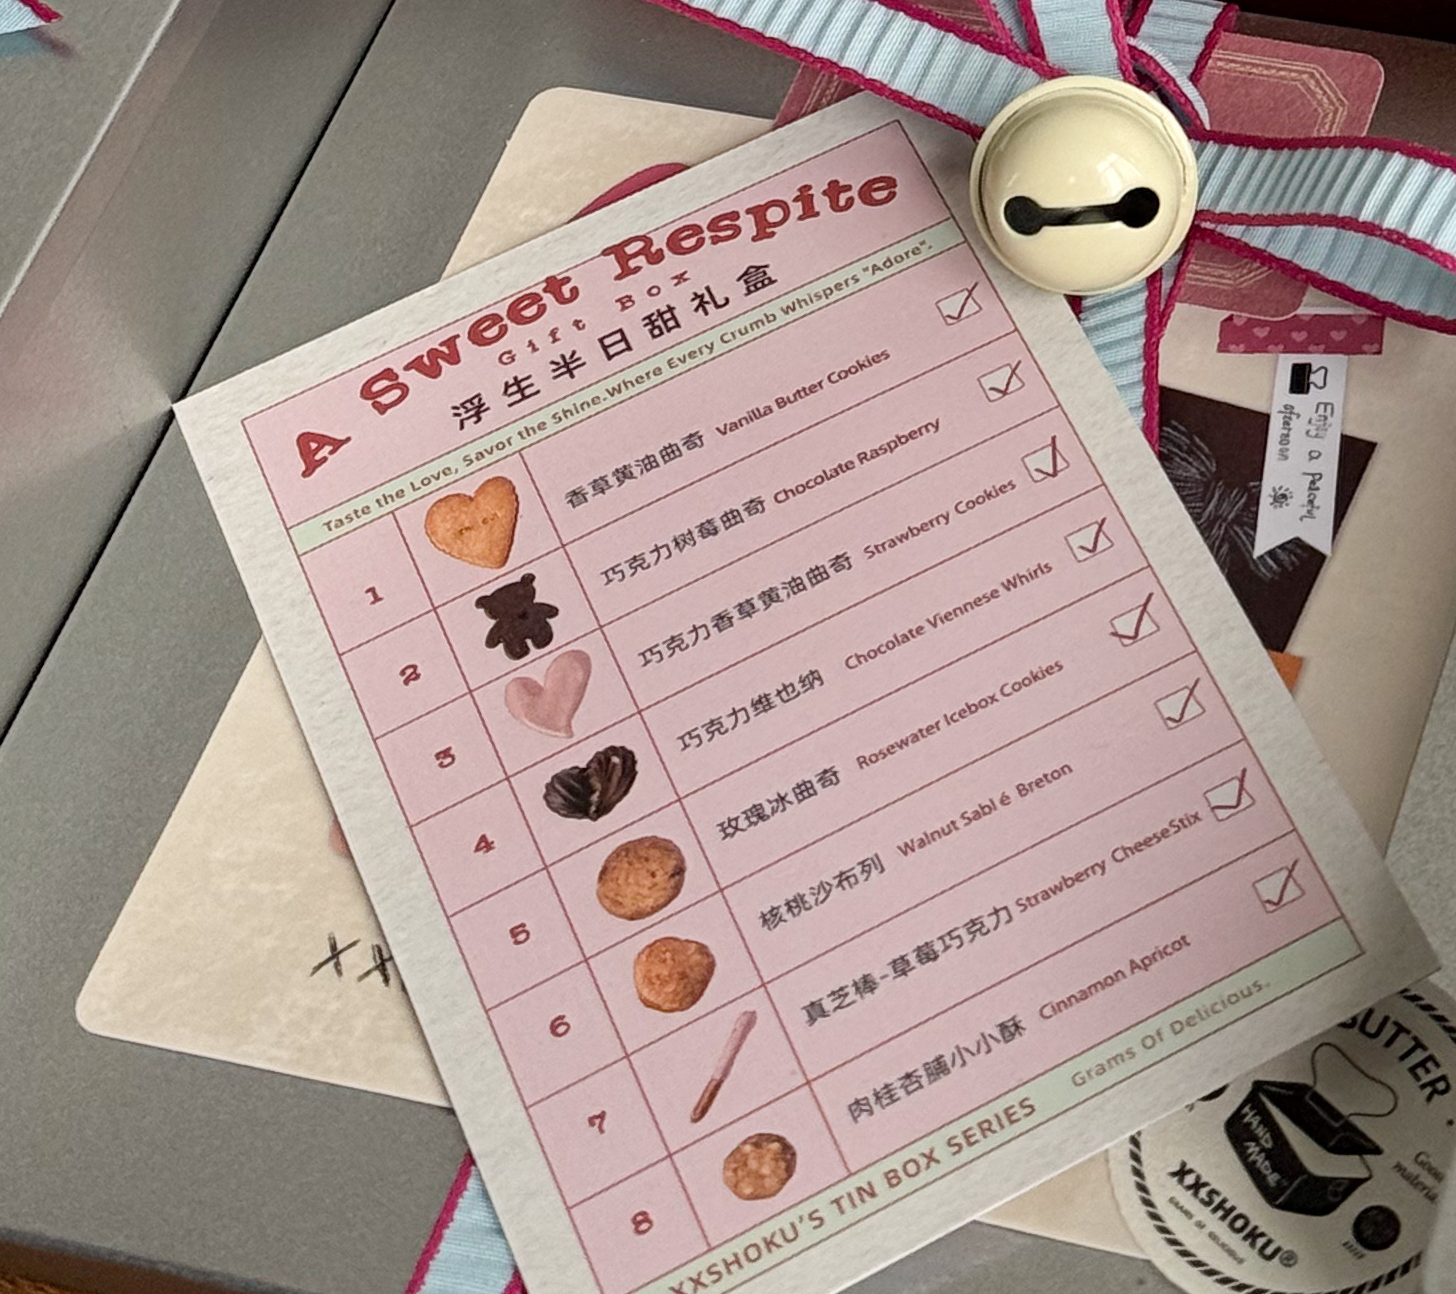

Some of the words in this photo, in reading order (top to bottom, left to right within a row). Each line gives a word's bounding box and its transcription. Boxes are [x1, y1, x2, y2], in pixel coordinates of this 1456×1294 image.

[295, 428, 352, 479] A
[358, 271, 581, 417] Sweet
[599, 174, 900, 282] Respite
[450, 262, 779, 432] 浮生半日甜礼盒
[498, 318, 585, 367] Gift
[322, 502, 371, 535] Taste
[375, 483, 406, 510] the
[408, 460, 460, 498] Love,
[462, 437, 515, 468] Savor
[517, 418, 549, 450] the
[665, 338, 716, 372] Every
[719, 310, 778, 346] Crumb
[779, 271, 860, 317] Whispers
[715, 404, 774, 439] Vanilla
[774, 380, 827, 412] Butter
[827, 346, 892, 386] Cookies
[563, 429, 706, 510] 香草黄油曲奇
[772, 456, 857, 505] Chocolate
[855, 417, 942, 467] Raspberry
[600, 495, 767, 587] 巧克力树莓曲奇
[862, 507, 953, 562] Strawberry
[953, 476, 1017, 516] Cookies
[364, 585, 386, 607] 1
[637, 551, 855, 669] 巧克力香草黄油曲奇
[843, 620, 926, 672] Chocolate
[926, 586, 1001, 631] Viennese
[1000, 559, 1054, 593] Whirls
[399, 662, 422, 687] 2
[675, 667, 826, 754] 巧克力维也纳
[855, 718, 943, 771] Rosewater
[943, 692, 1000, 727] Icebox
[999, 659, 1065, 700] Cookies
[433, 746, 457, 770] 3
[472, 833, 496, 855] 4
[715, 765, 842, 842] 玫瑰冰曲奇
[896, 817, 960, 859] Walnut
[1013, 761, 1074, 800] Breton
[758, 851, 887, 933] 核桃沙布列
[1014, 859, 1108, 915] Strawberry
[508, 922, 532, 947] 5
[1037, 969, 1128, 1022] Cinnamon
[1127, 933, 1193, 977] Apricot
[548, 1014, 572, 1038] 6
[1069, 1042, 1138, 1090] Grams
[1139, 1026, 1166, 1053] Of
[587, 1110, 609, 1135] 7
[829, 1181, 879, 1218] TIN
[883, 1146, 942, 1191] BOX
[945, 1097, 1038, 1157] SERIES
[629, 1210, 655, 1237] 8
[1391, 1160, 1440, 1205] materia
